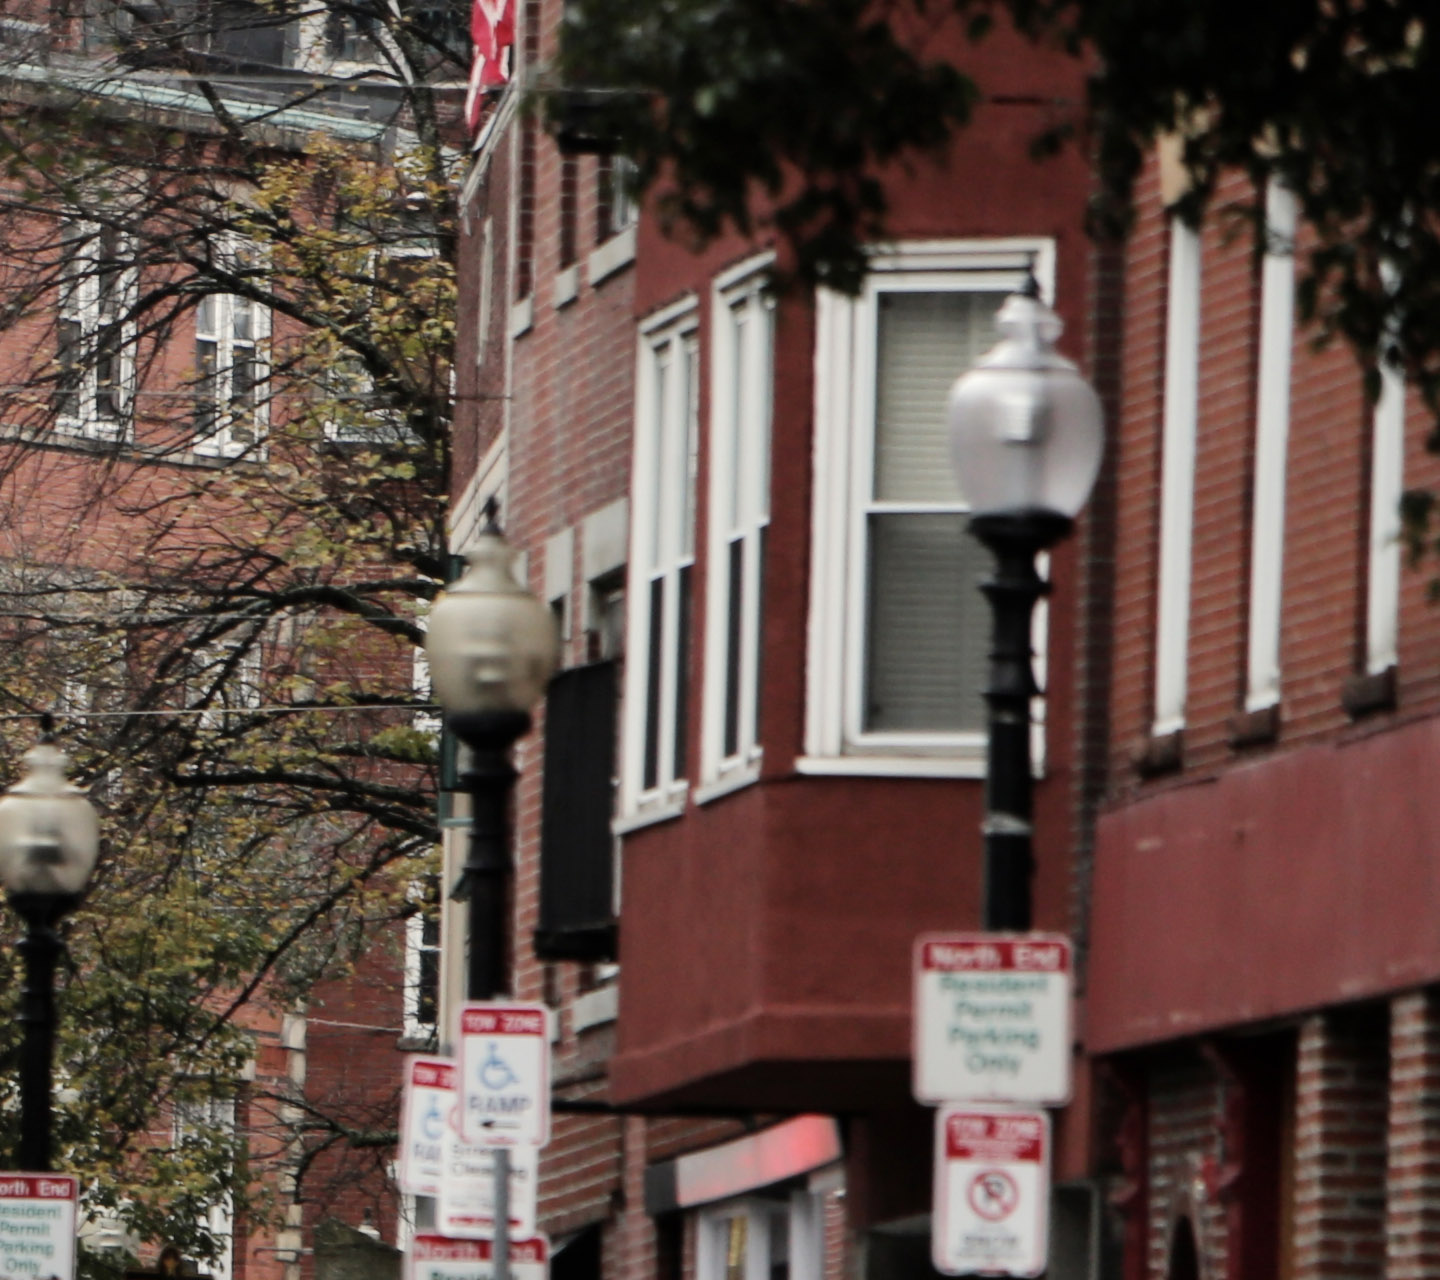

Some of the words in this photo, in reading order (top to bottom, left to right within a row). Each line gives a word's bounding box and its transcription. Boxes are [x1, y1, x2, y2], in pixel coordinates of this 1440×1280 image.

[930, 945, 1000, 968] North
[1013, 945, 1060, 968] End
[955, 1000, 1032, 1018] Permit
[948, 1025, 1041, 1051] Parking
[965, 1052, 1021, 1077] Only
[469, 1096, 530, 1113] RAMP
[39, 1180, 70, 1197] End
[0, 1221, 51, 1236] Permit
[5, 1257, 41, 1276] Only
